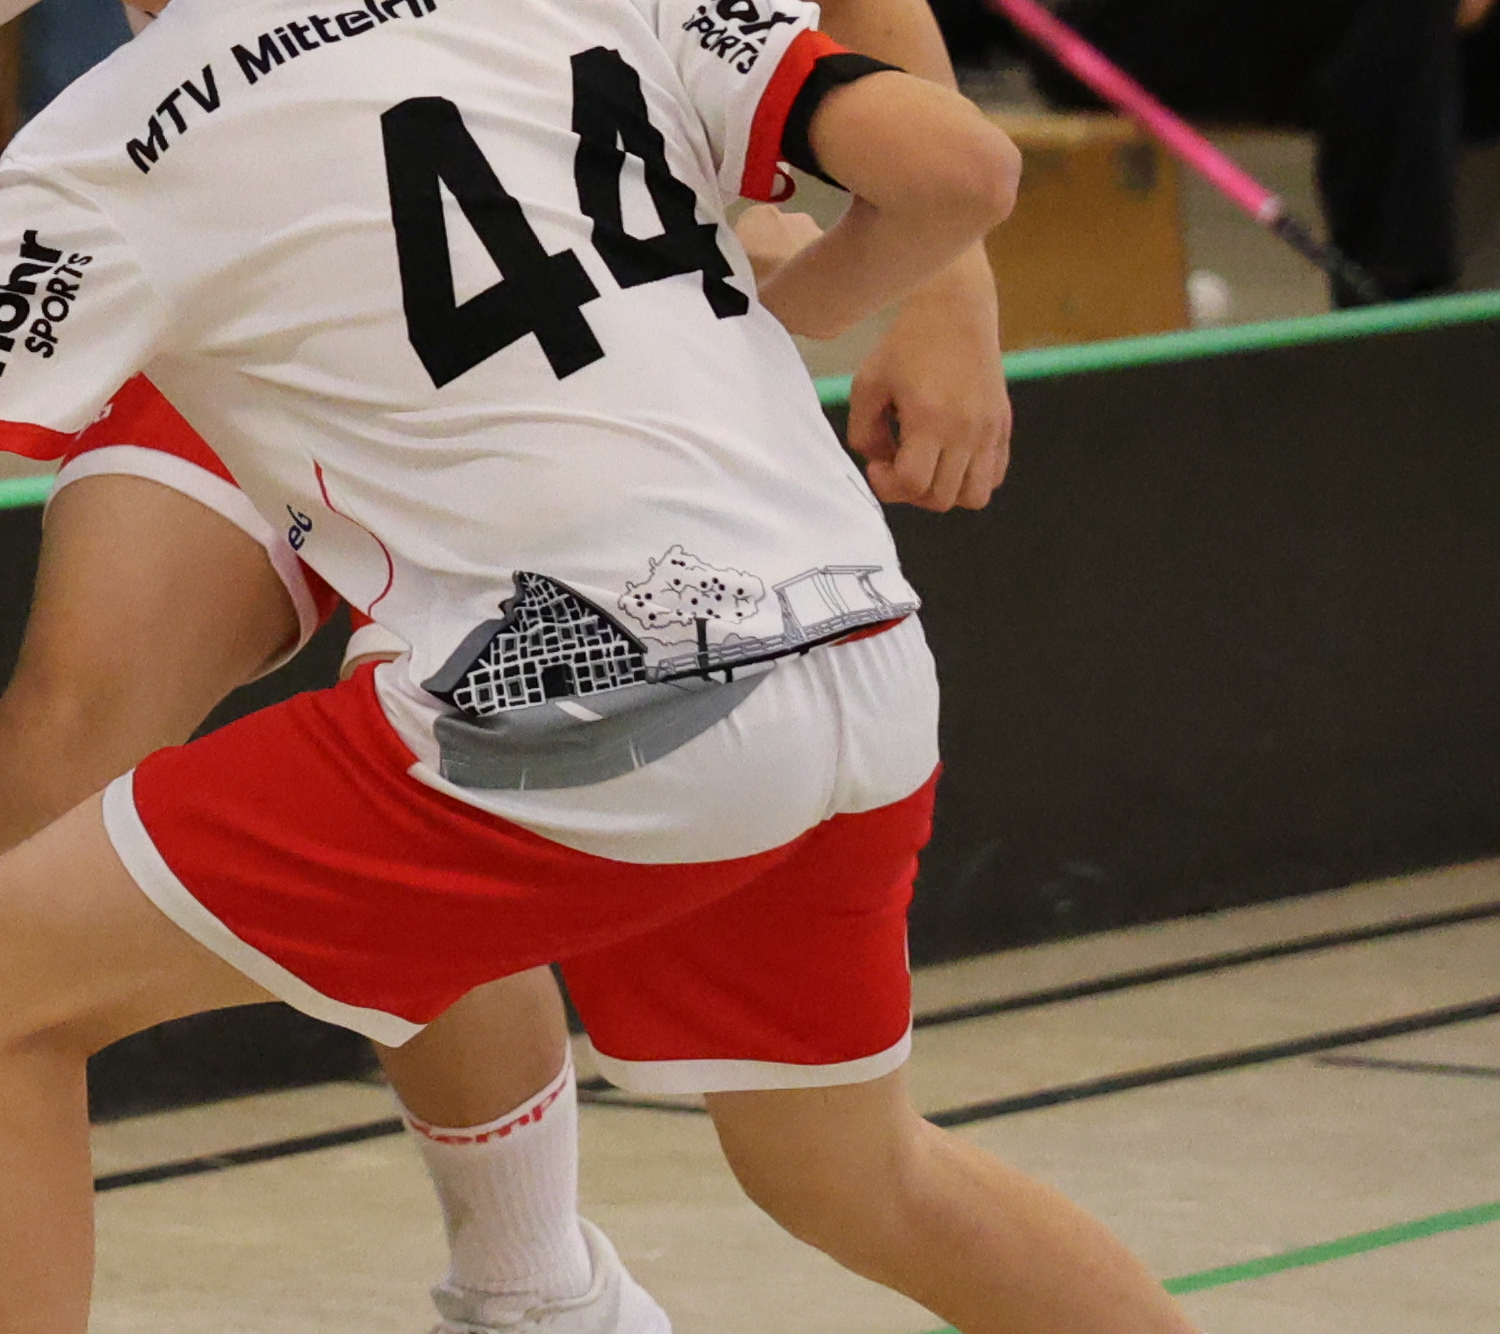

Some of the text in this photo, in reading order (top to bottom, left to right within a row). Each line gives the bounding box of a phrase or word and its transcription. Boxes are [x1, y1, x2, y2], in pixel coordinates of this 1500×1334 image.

[126, 64, 221, 174] MTV
[380, 45, 749, 390] 44
[24, 252, 94, 359] SPORTS
